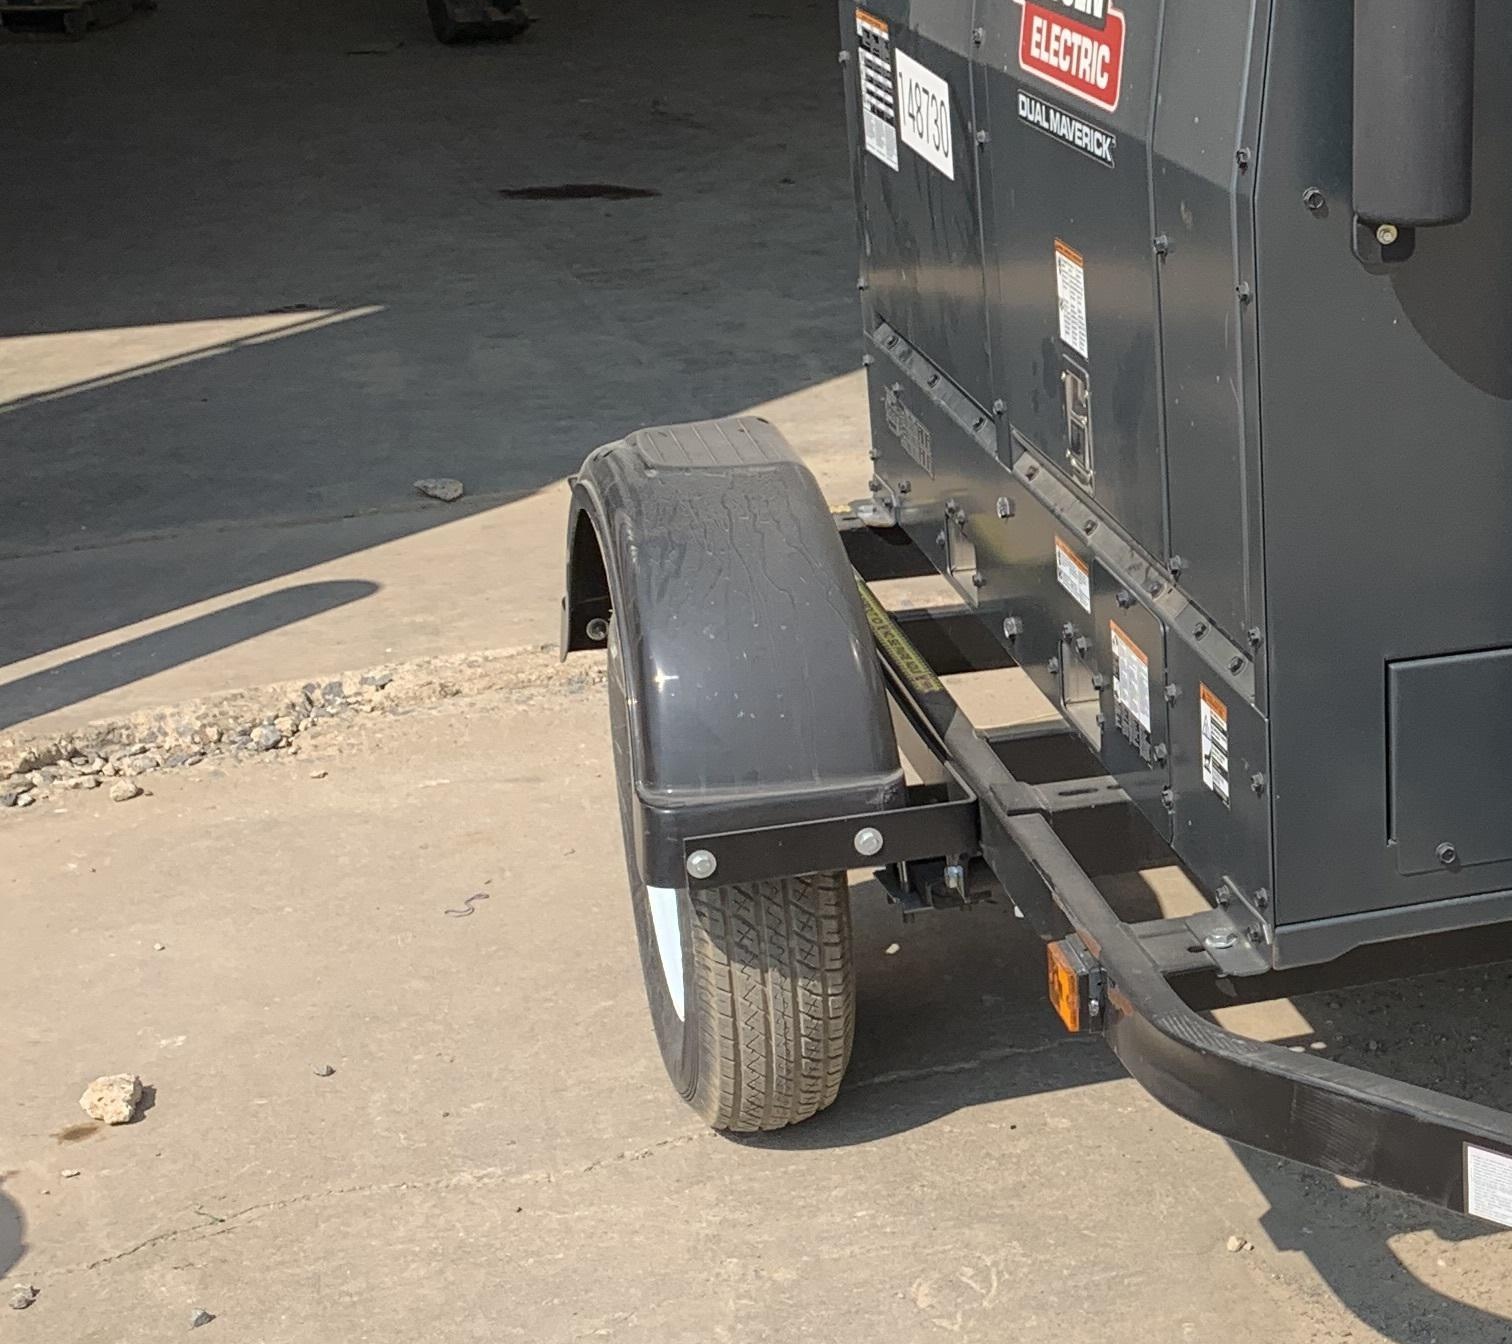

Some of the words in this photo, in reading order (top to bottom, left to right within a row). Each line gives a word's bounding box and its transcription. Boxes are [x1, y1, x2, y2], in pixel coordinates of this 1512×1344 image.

[1030, 15, 1111, 90] ELECTRIC
[899, 71, 950, 159] 148730
[1018, 94, 1049, 129] DUAL
[1049, 111, 1113, 162] MAVERICK
